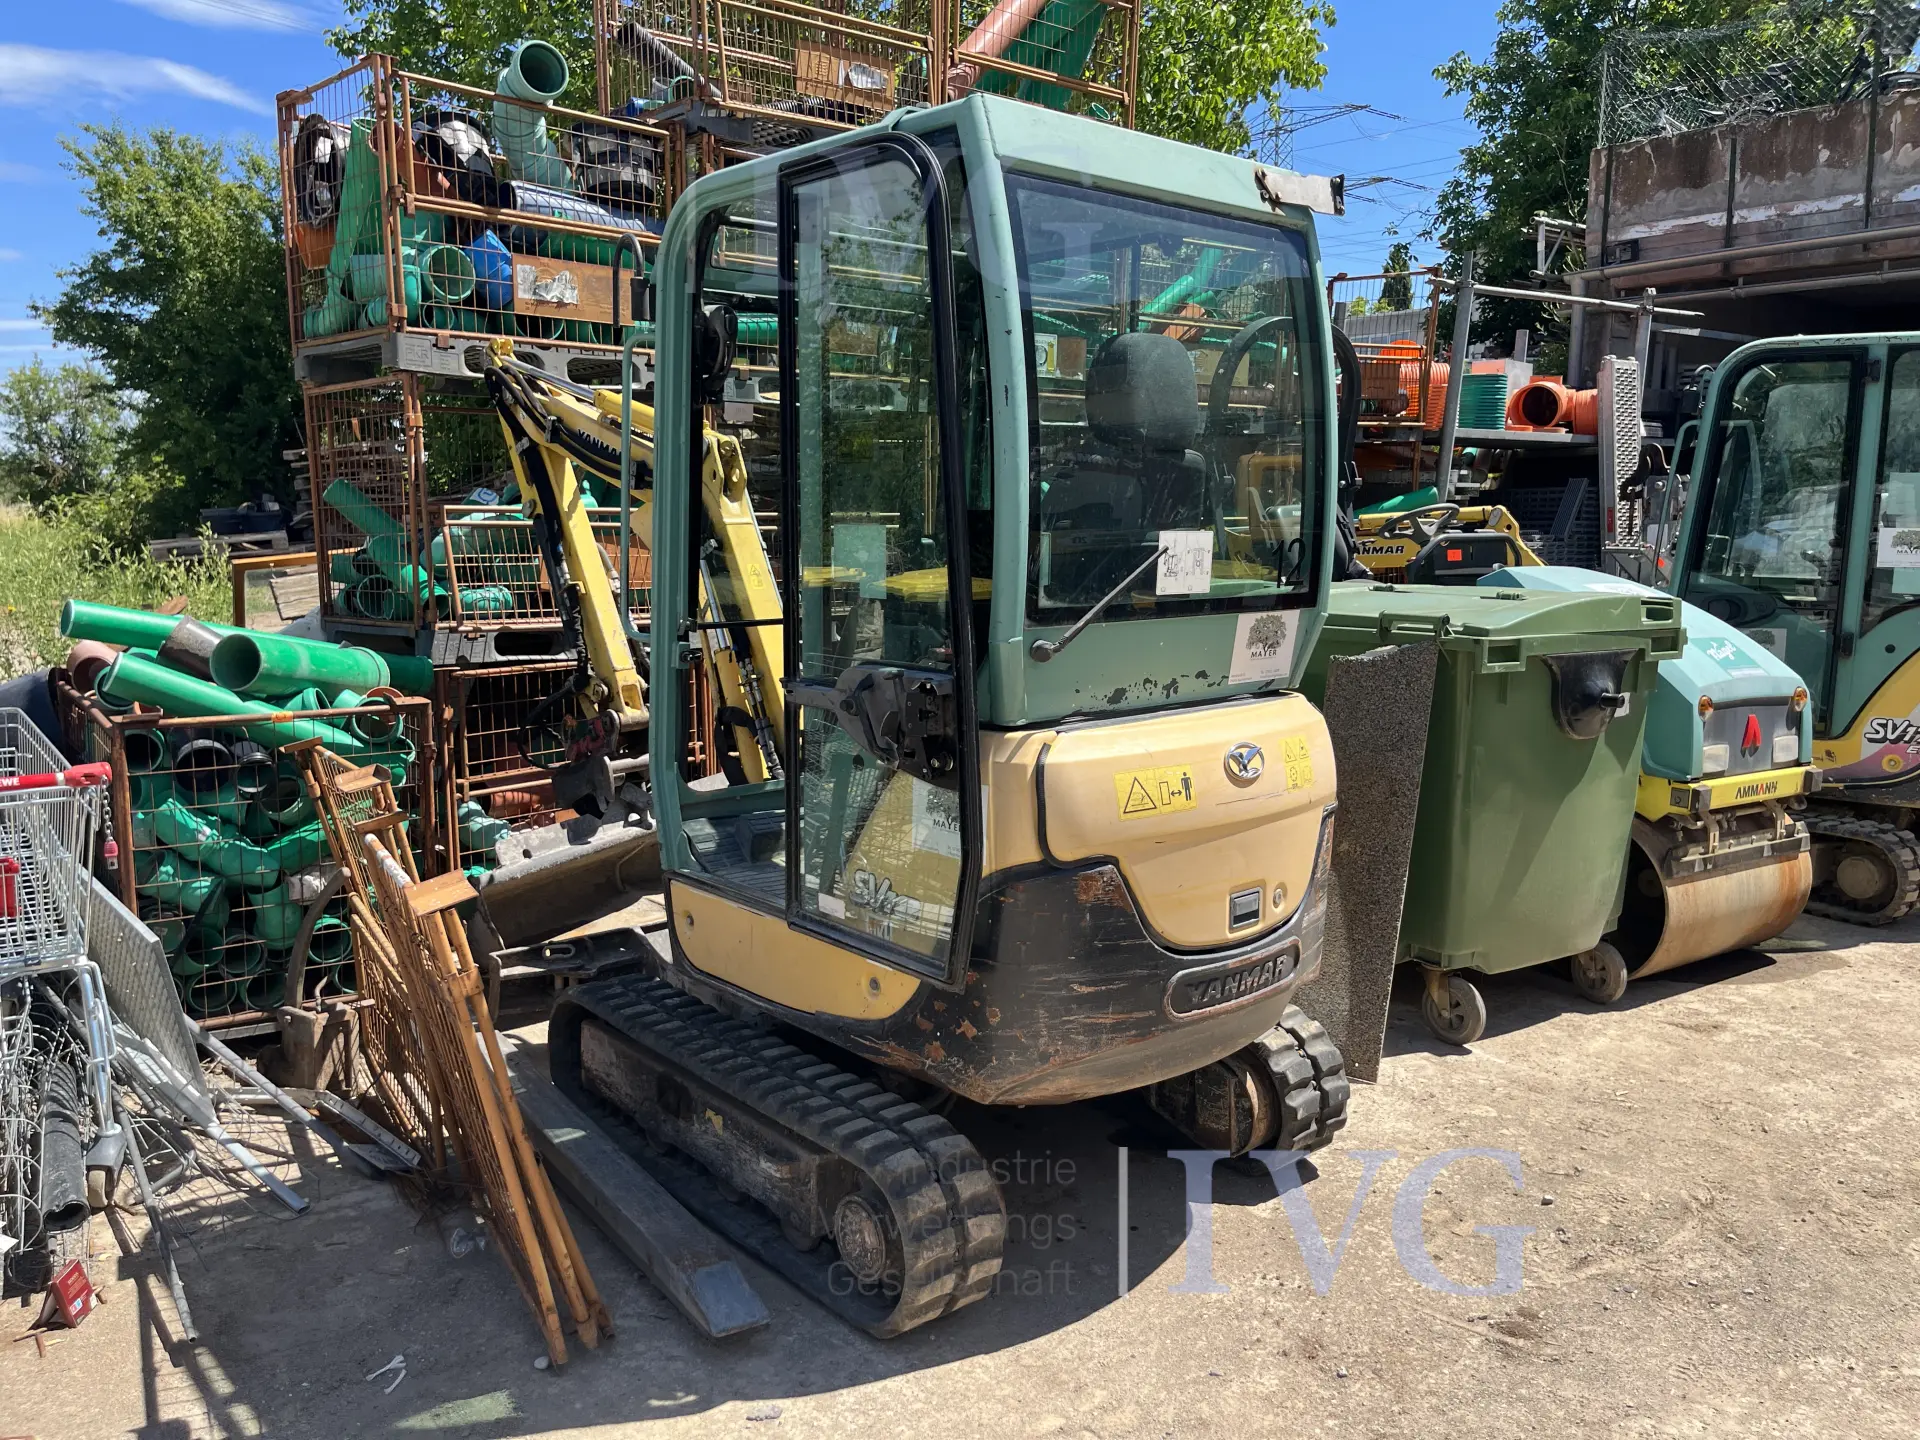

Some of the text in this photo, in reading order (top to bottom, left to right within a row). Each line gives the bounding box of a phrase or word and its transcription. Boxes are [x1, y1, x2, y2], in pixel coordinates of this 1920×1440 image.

[577, 428, 622, 456] YANMA
[1352, 545, 1405, 555] ANMAR
[1271, 537, 1306, 588] 12
[1250, 649, 1277, 659] MAYER
[0, 776, 20, 787] WE
[1735, 781, 1778, 799] AMMANN
[933, 817, 960, 832] MAYE
[1185, 954, 1289, 1006] YANMAR
